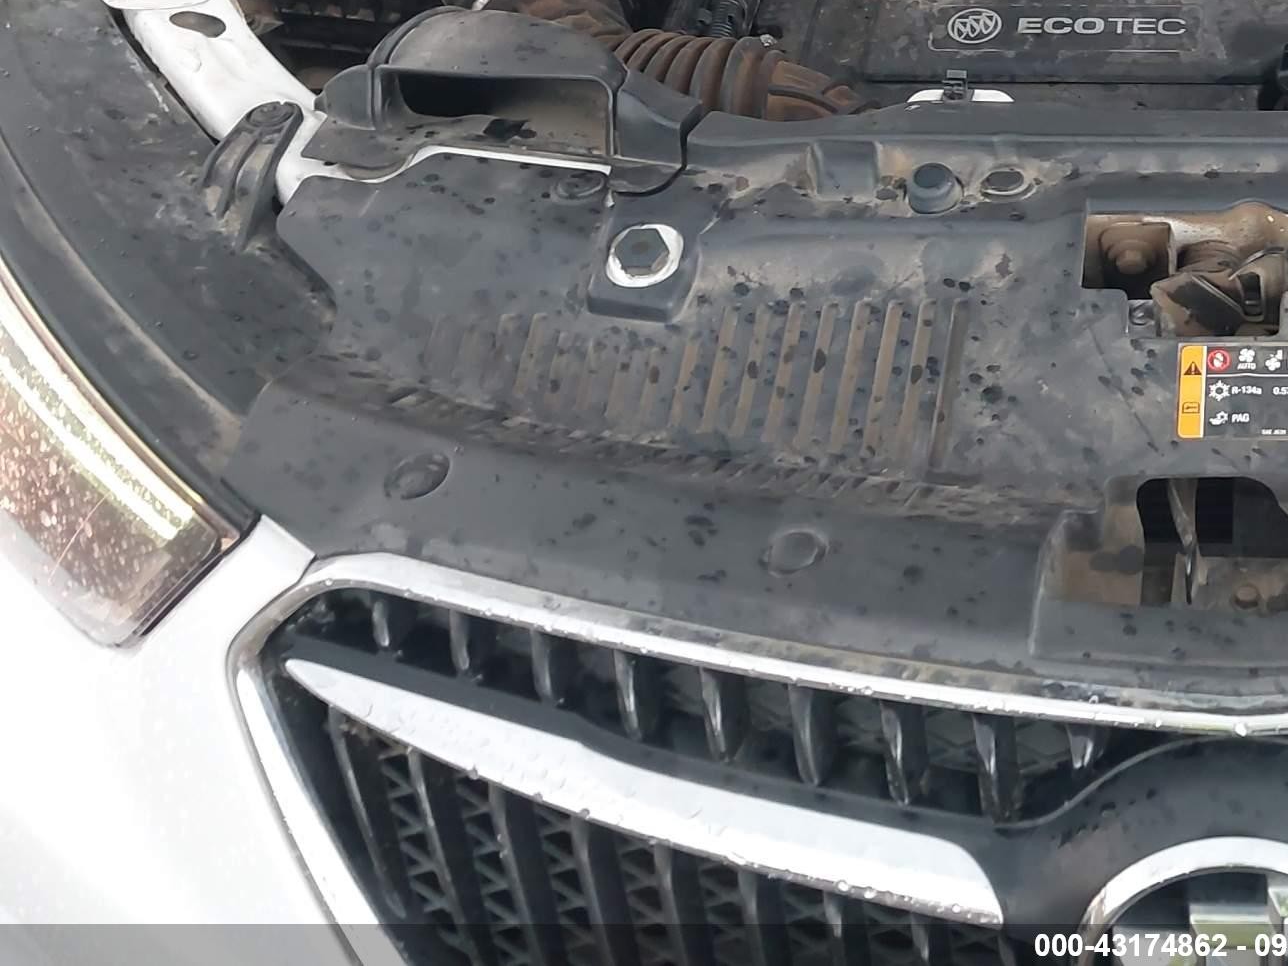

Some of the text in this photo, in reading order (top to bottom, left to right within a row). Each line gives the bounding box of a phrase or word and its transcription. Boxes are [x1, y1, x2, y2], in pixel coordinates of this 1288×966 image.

[1017, 18, 1187, 36] ECOTEC
[1237, 362, 1257, 370] AUTO
[1231, 386, 1263, 395] R-134a
[1231, 413, 1250, 423] PAG
